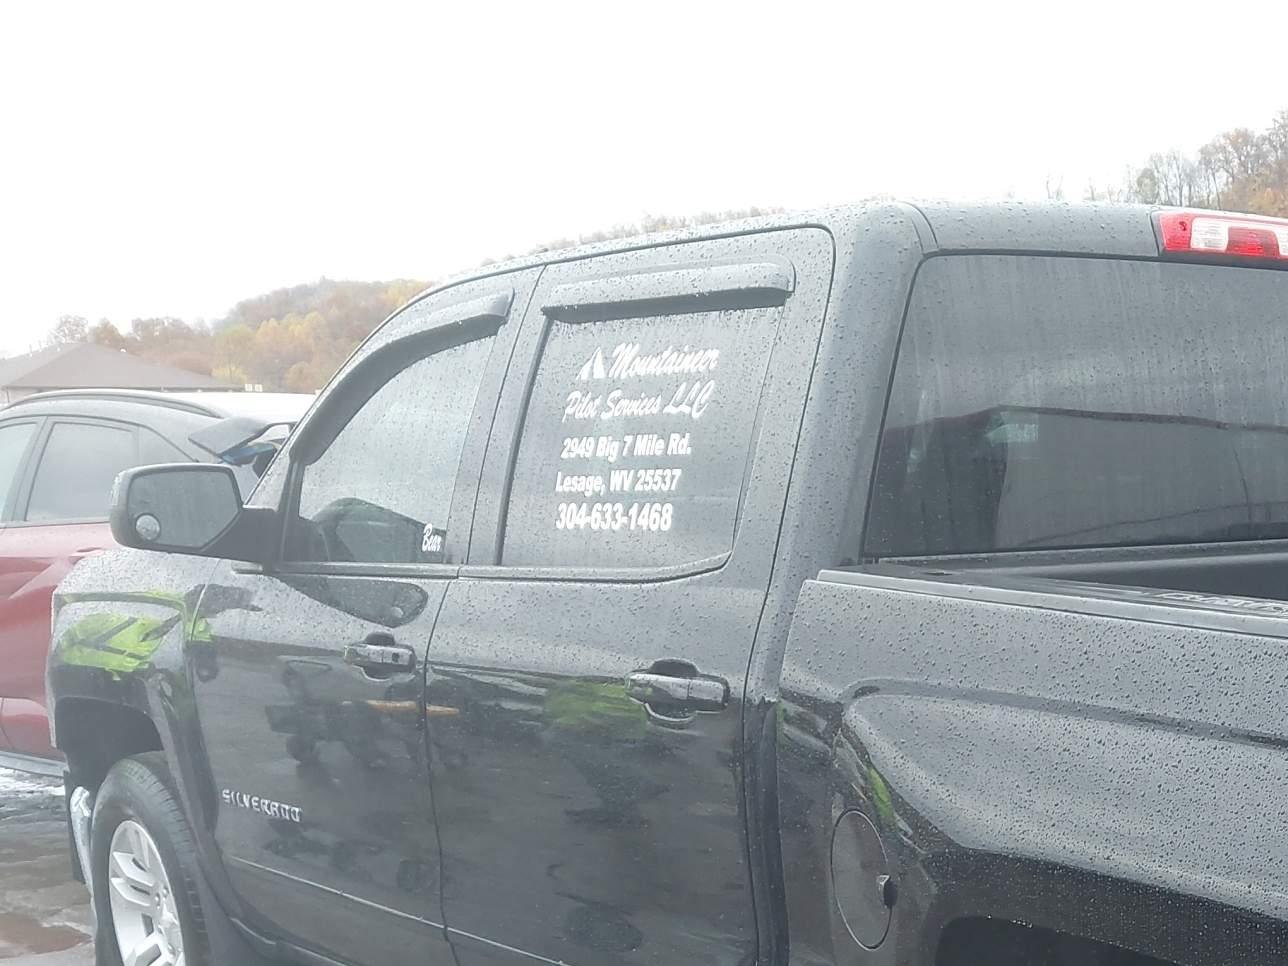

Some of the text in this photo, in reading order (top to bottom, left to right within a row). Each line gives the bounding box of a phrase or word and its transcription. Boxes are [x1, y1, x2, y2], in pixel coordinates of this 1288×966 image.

[562, 379, 716, 423] Pilot Services LLC
[560, 433, 693, 462] 2949 Big 7 Mile Rd.
[555, 468, 682, 497] Lesage, WV 25537
[556, 503, 673, 531] 304-633-1468
[222, 788, 303, 823] SILVERADO
